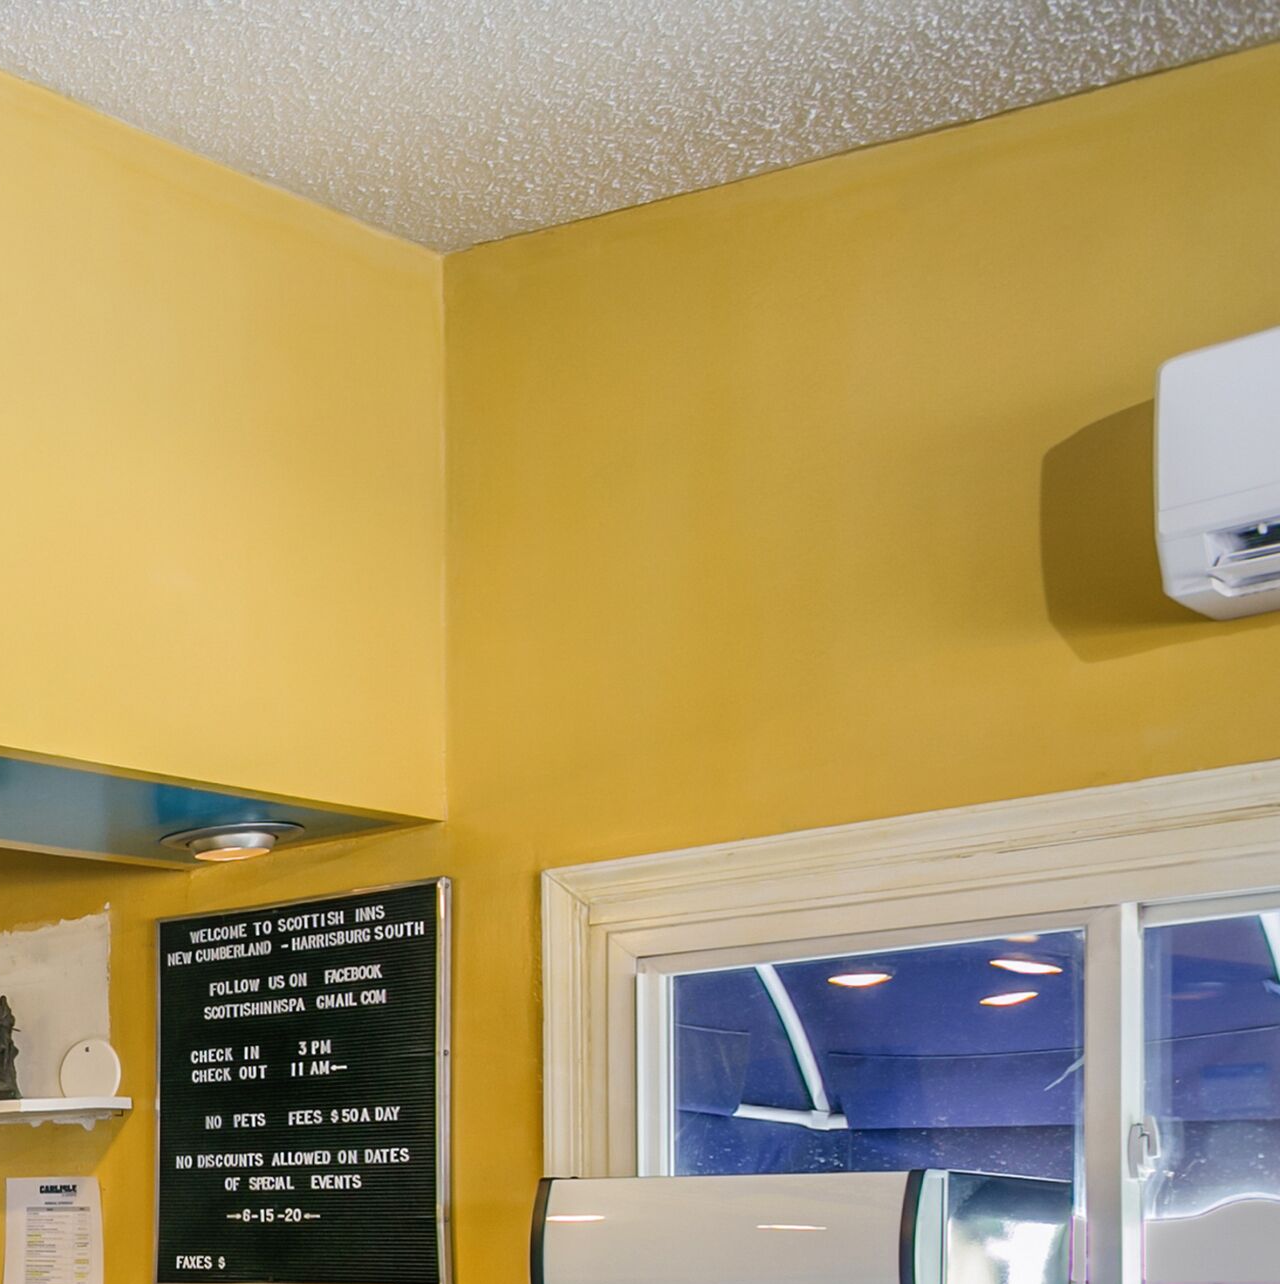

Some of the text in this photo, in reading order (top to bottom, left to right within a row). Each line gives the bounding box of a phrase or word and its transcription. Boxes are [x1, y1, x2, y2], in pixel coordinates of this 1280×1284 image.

[190, 905, 385, 944] WELCOME TO SCOTTISH INNS
[167, 951, 192, 967] NEW
[196, 940, 272, 963] CUMBERLAND
[374, 921, 425, 941] SOUTH
[210, 964, 383, 997] FOLLOW US ON FACEBOOK
[204, 989, 386, 1020] SCOTTISHINNSPA GMAIL COM
[191, 1040, 332, 1064] CHECK IN 3 PM
[191, 1060, 330, 1083] CHECK OUT 11 AM
[205, 1115, 222, 1129] NO
[233, 1113, 266, 1128] PETS
[288, 1110, 323, 1126] FEES
[375, 1106, 400, 1121] DAY
[176, 1148, 410, 1169] NO DISCOUNTS ALLOWED ON DATES
[224, 1175, 362, 1191] OF SPECIAL EVENTS
[176, 1256, 212, 1270] FAXES
